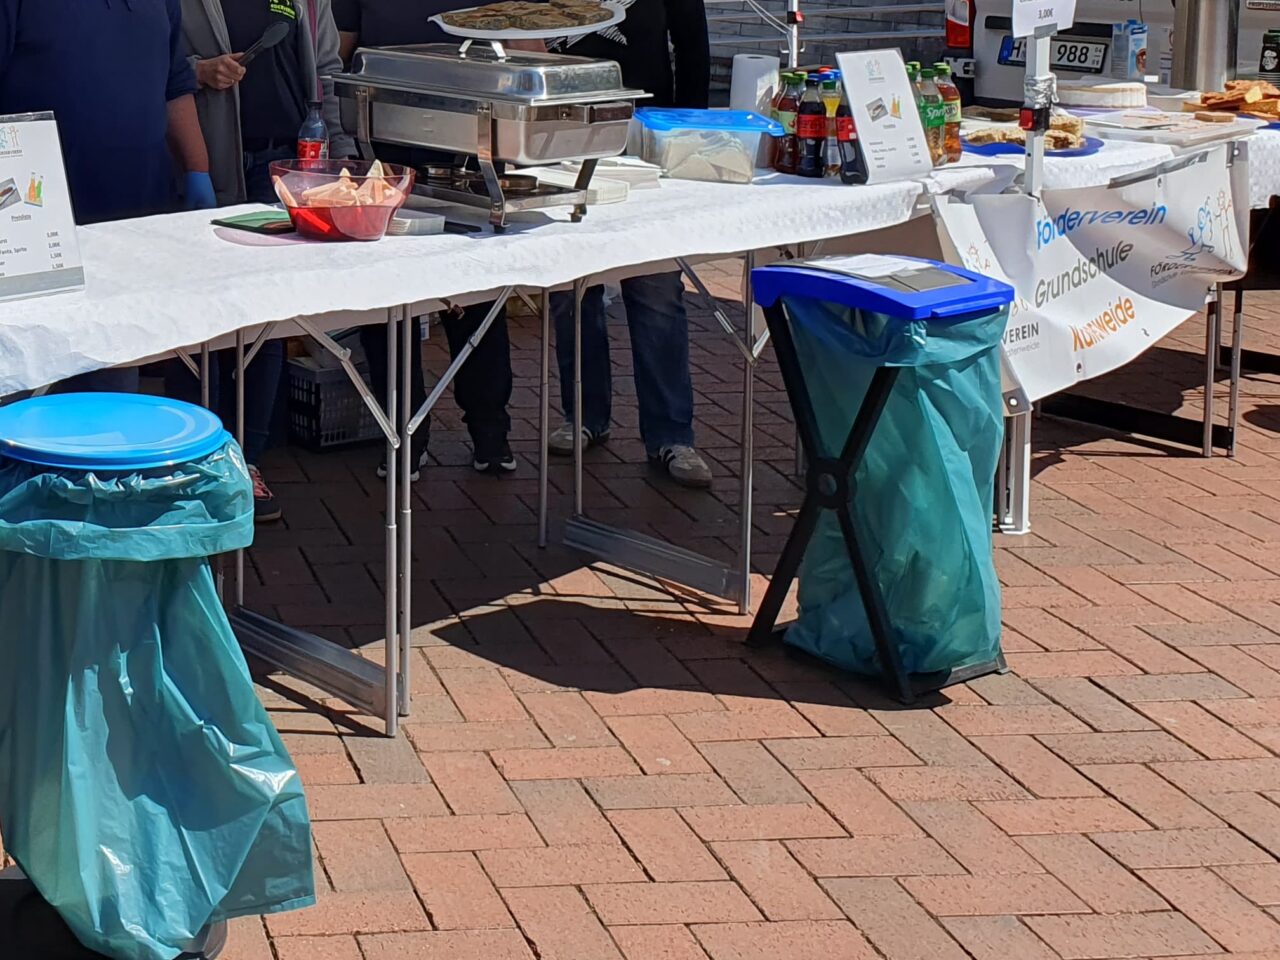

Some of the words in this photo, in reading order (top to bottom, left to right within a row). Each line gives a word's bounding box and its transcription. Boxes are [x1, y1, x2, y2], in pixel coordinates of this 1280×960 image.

[1057, 44, 1089, 64] 988
[1036, 201, 1167, 250] Förderverein
[1035, 240, 1134, 308] Grundschule
